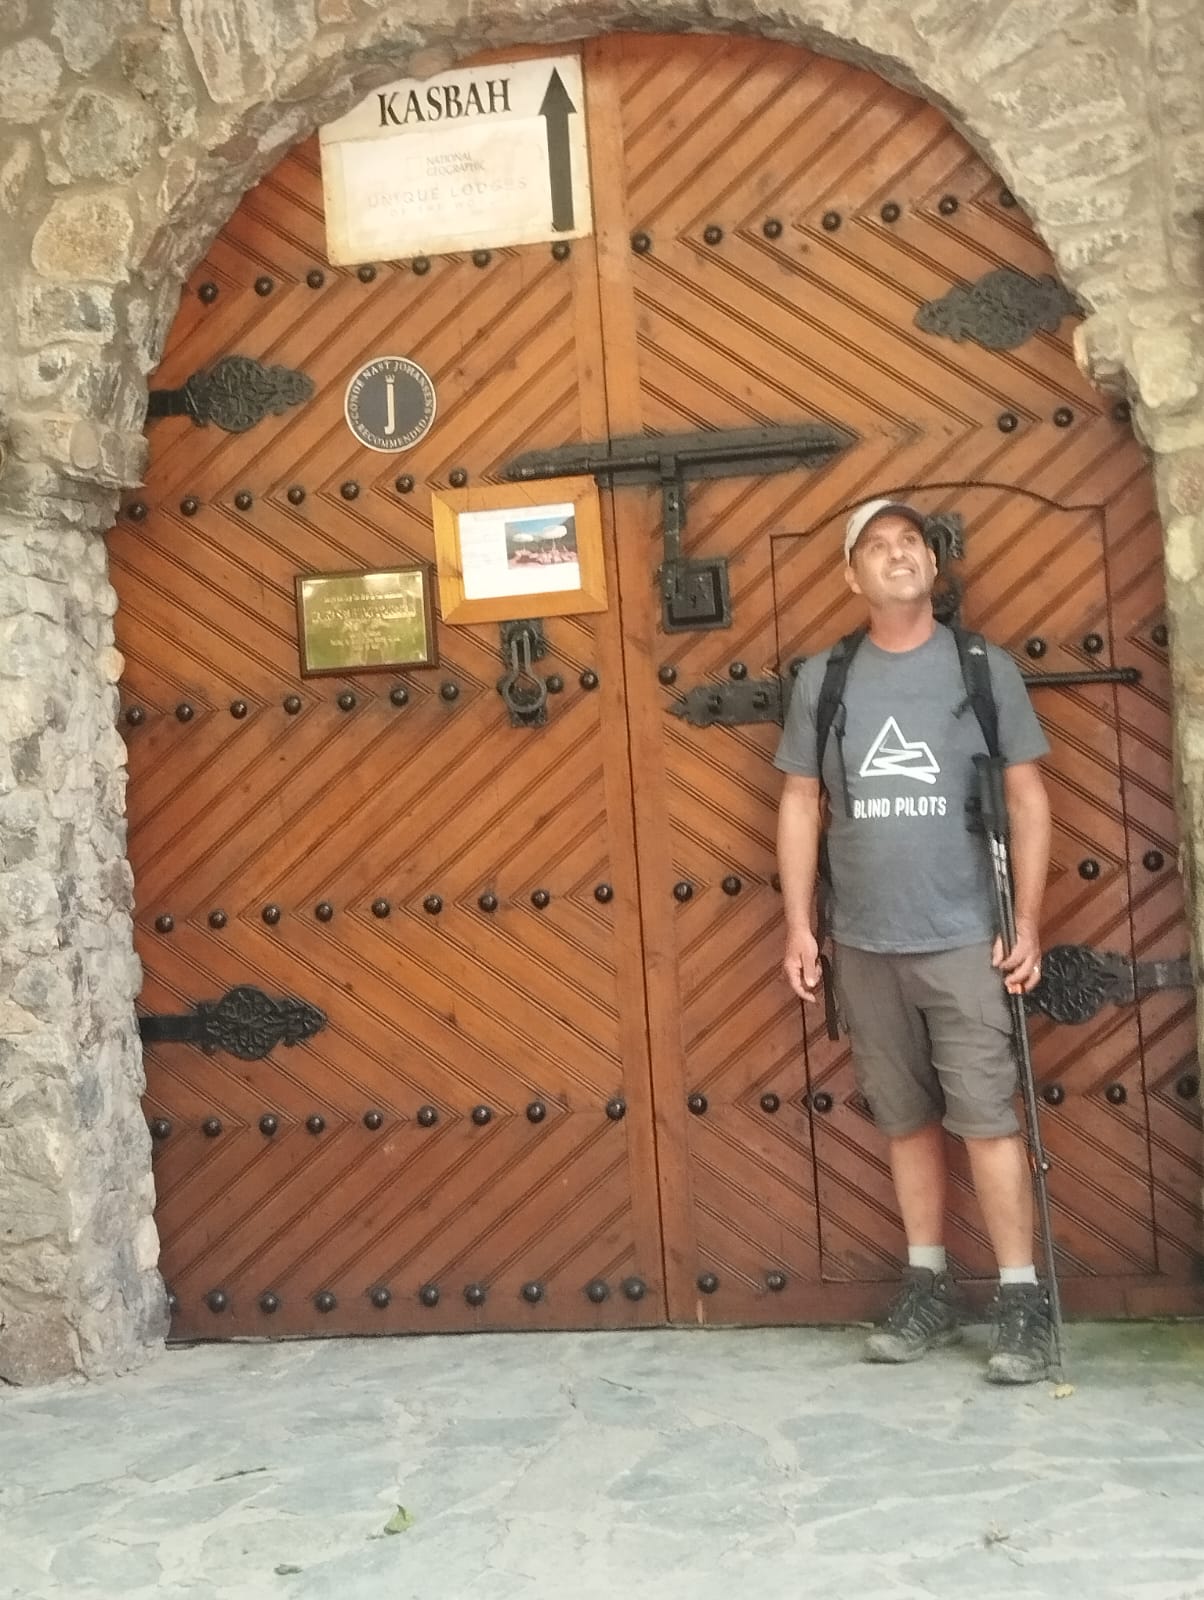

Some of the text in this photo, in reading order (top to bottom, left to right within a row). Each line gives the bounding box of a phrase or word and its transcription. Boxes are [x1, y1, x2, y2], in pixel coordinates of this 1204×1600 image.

[378, 78, 512, 127] KASBAH
[426, 152, 473, 166] NATIONAL
[426, 160, 486, 177] GEOGRAPHIC
[367, 187, 440, 209] UNIQUE
[362, 360, 390, 380] NAST
[393, 360, 433, 415] JOHANSENS
[357, 418, 427, 449] RECOMMENDED
[854, 796, 947, 819] BLIND PILOTS
